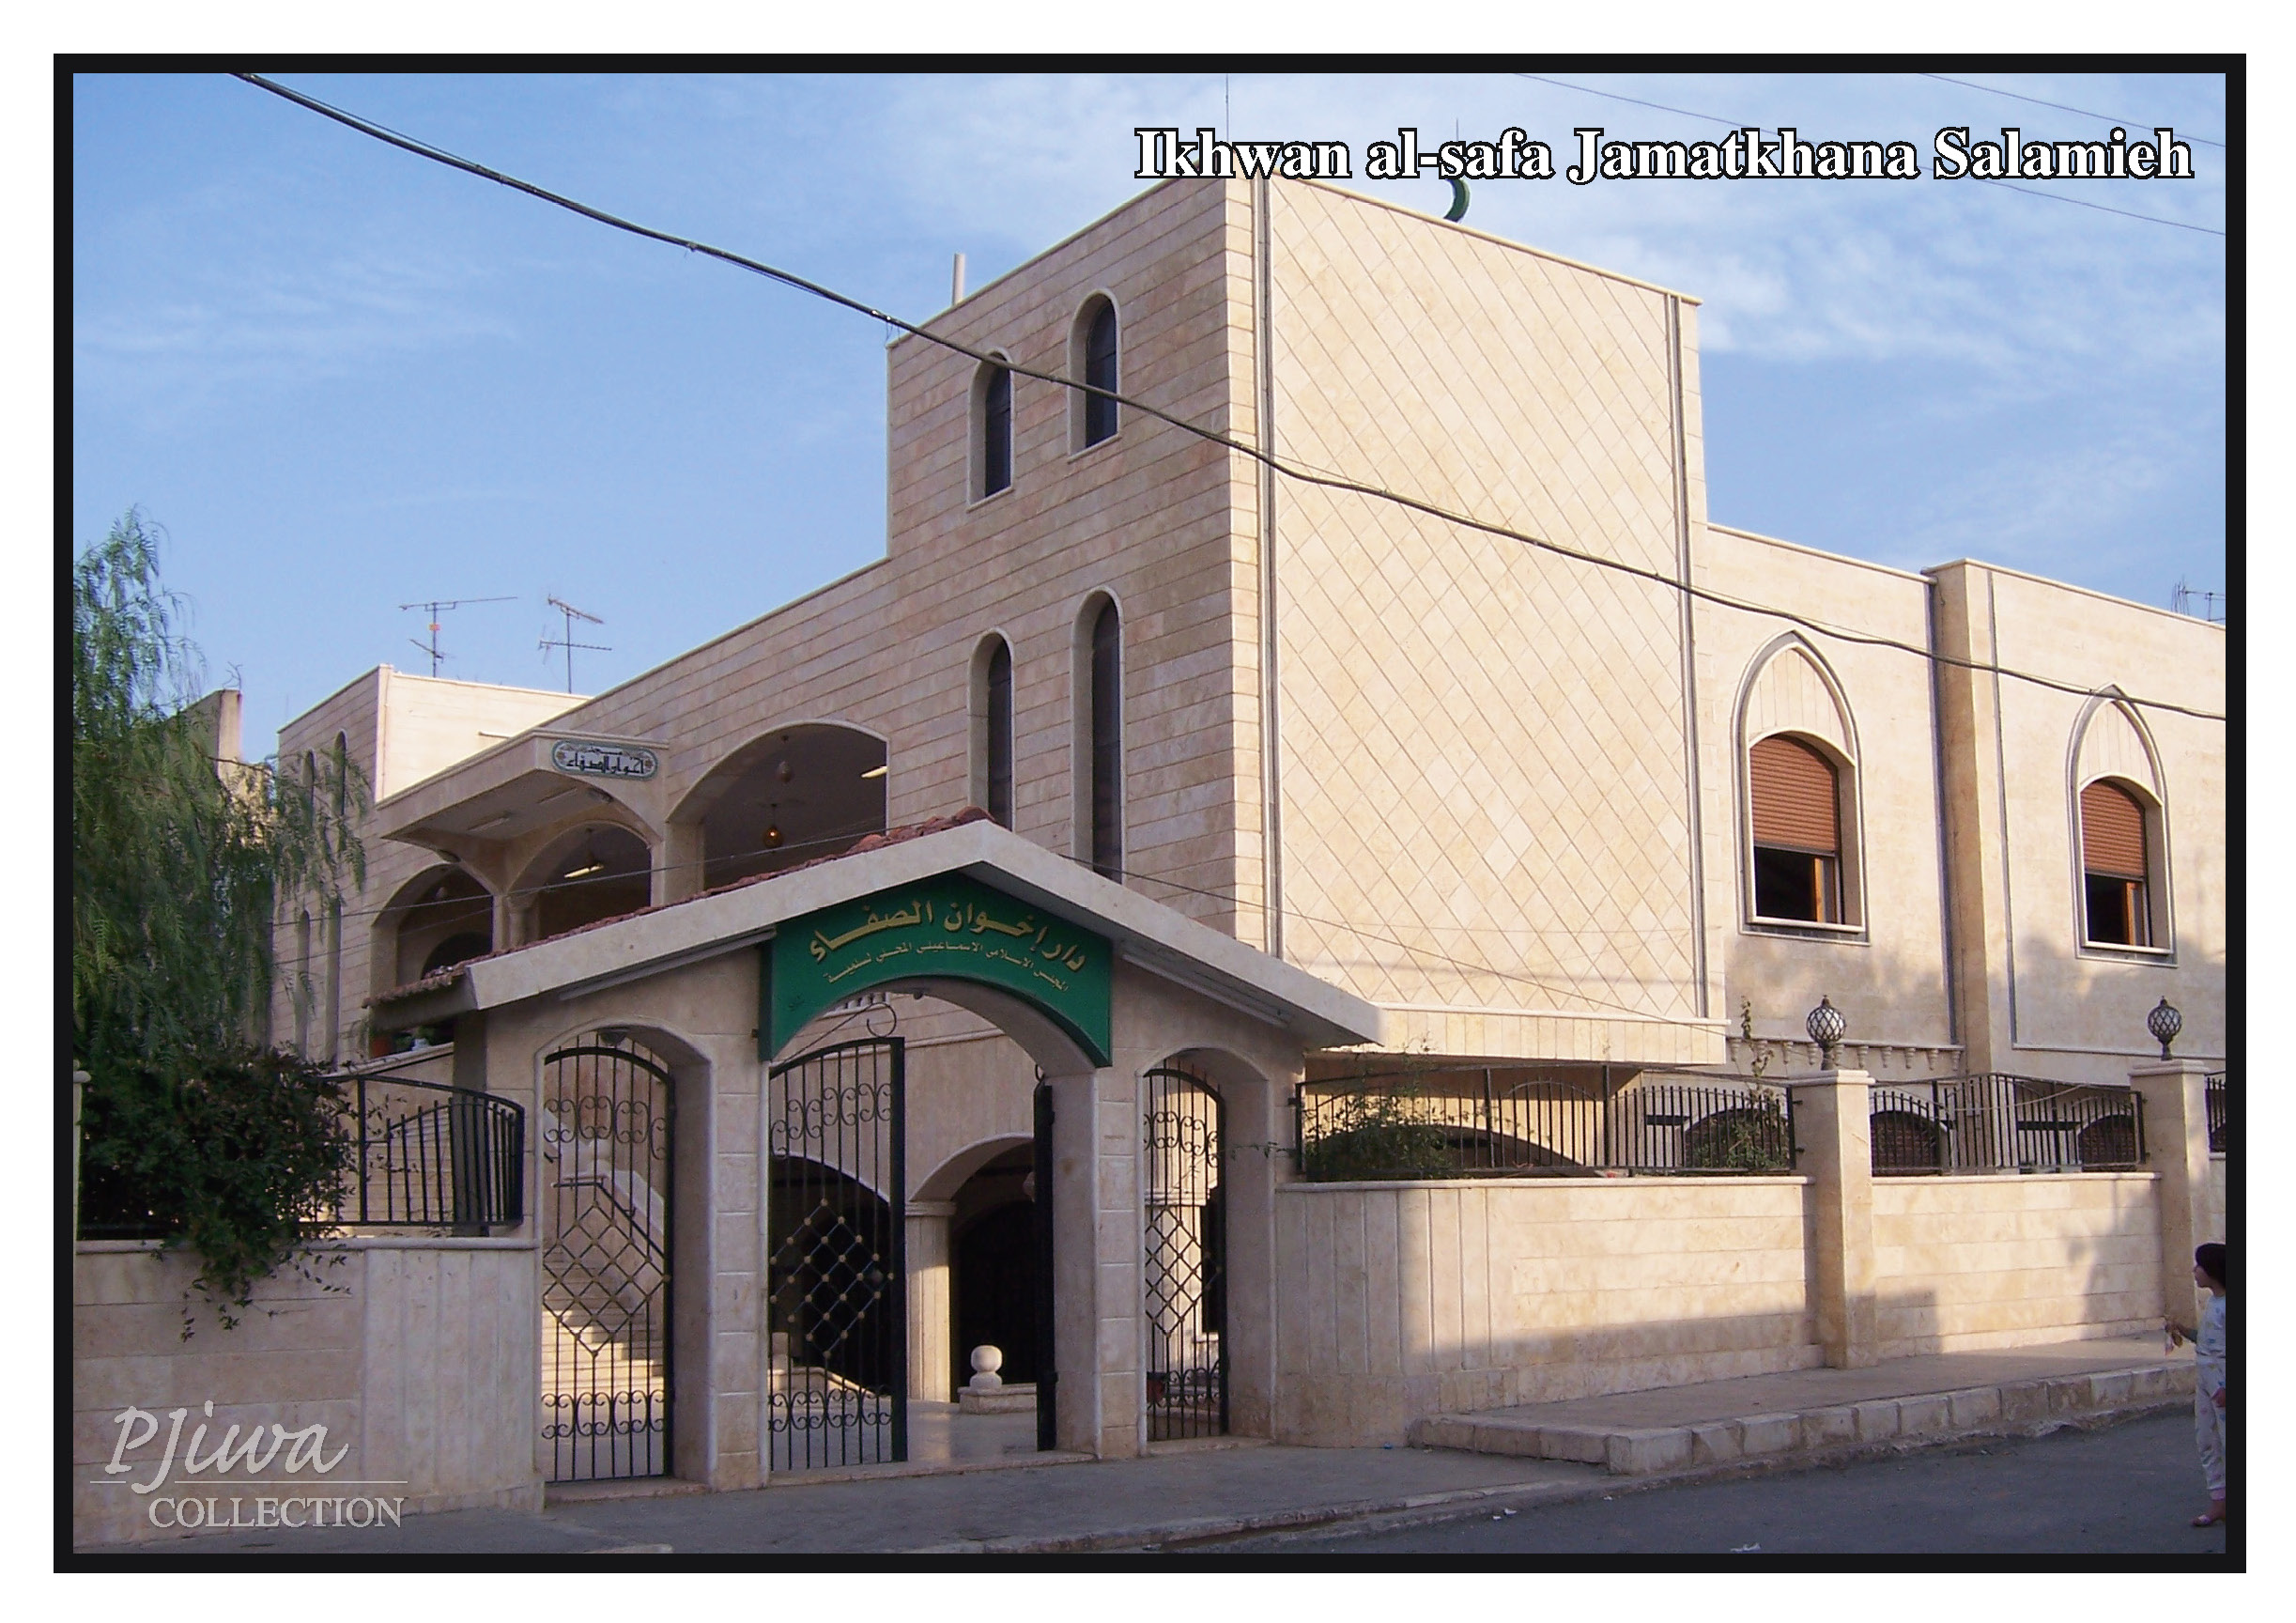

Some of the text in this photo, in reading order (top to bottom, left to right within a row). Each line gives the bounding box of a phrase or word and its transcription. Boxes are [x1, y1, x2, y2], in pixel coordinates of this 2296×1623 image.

[809, 899, 1086, 972] دار إخوان الصفاء
